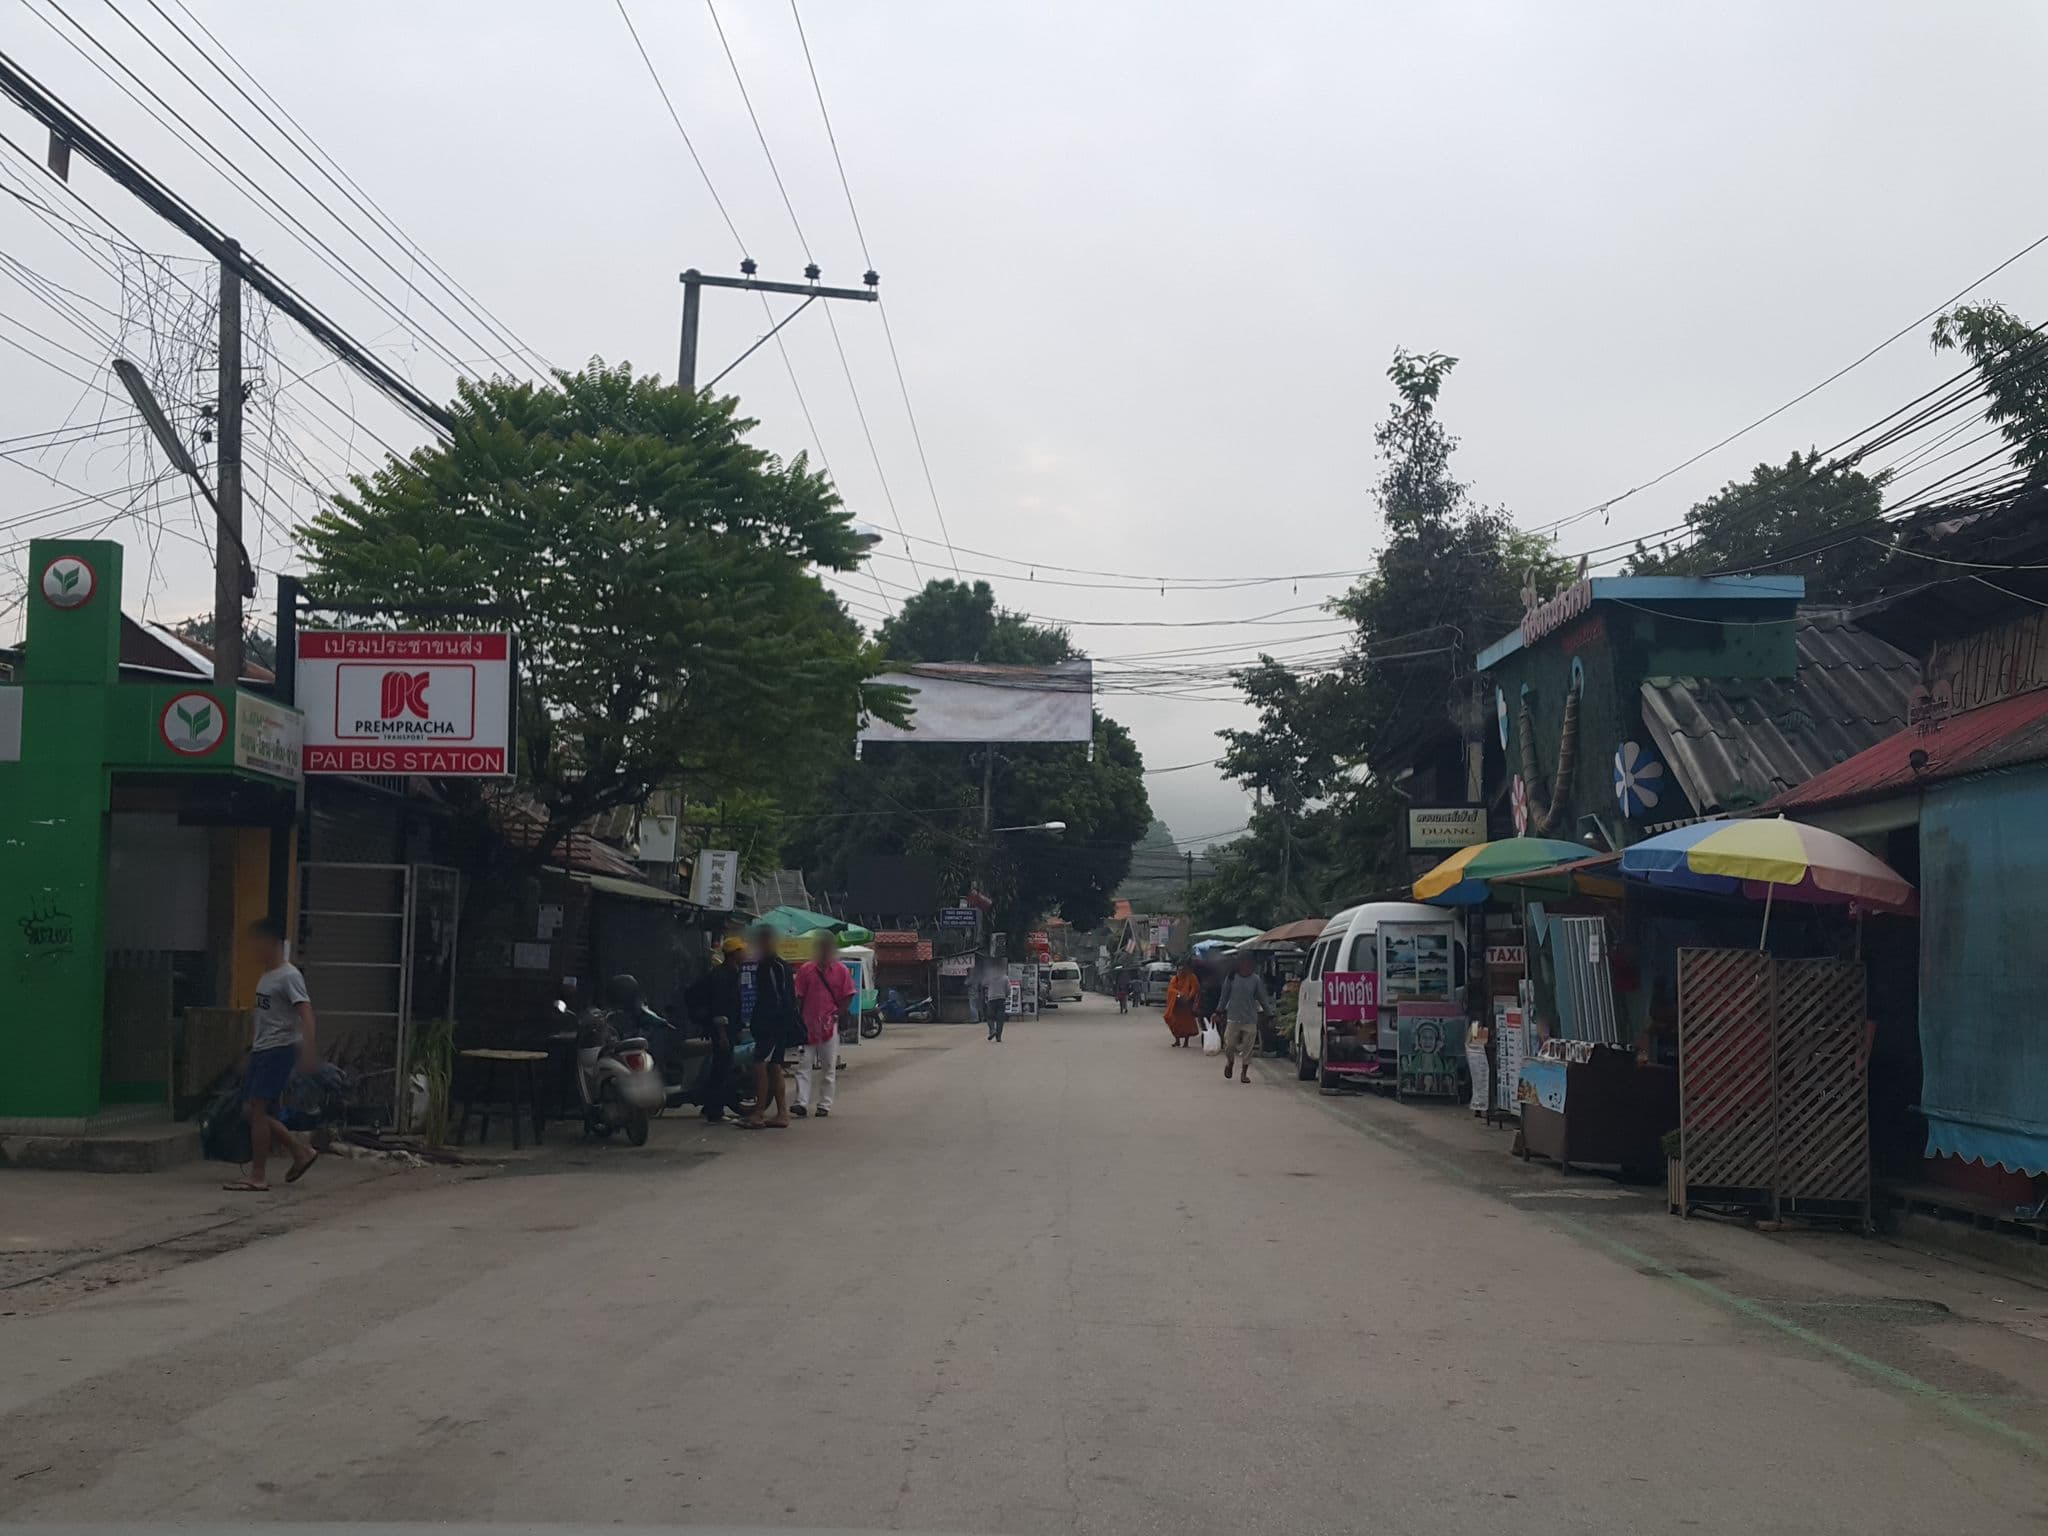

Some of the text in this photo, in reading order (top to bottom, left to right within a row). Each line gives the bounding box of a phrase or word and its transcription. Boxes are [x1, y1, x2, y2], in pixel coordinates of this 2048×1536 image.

[324, 634, 483, 655] เปรมประชาขนส่ง
[355, 720, 455, 734] PREMPRACHA
[310, 751, 500, 771] PAI BUS STATION
[1422, 827, 1475, 835] DUANG
[1488, 948, 1521, 962] TAXI
